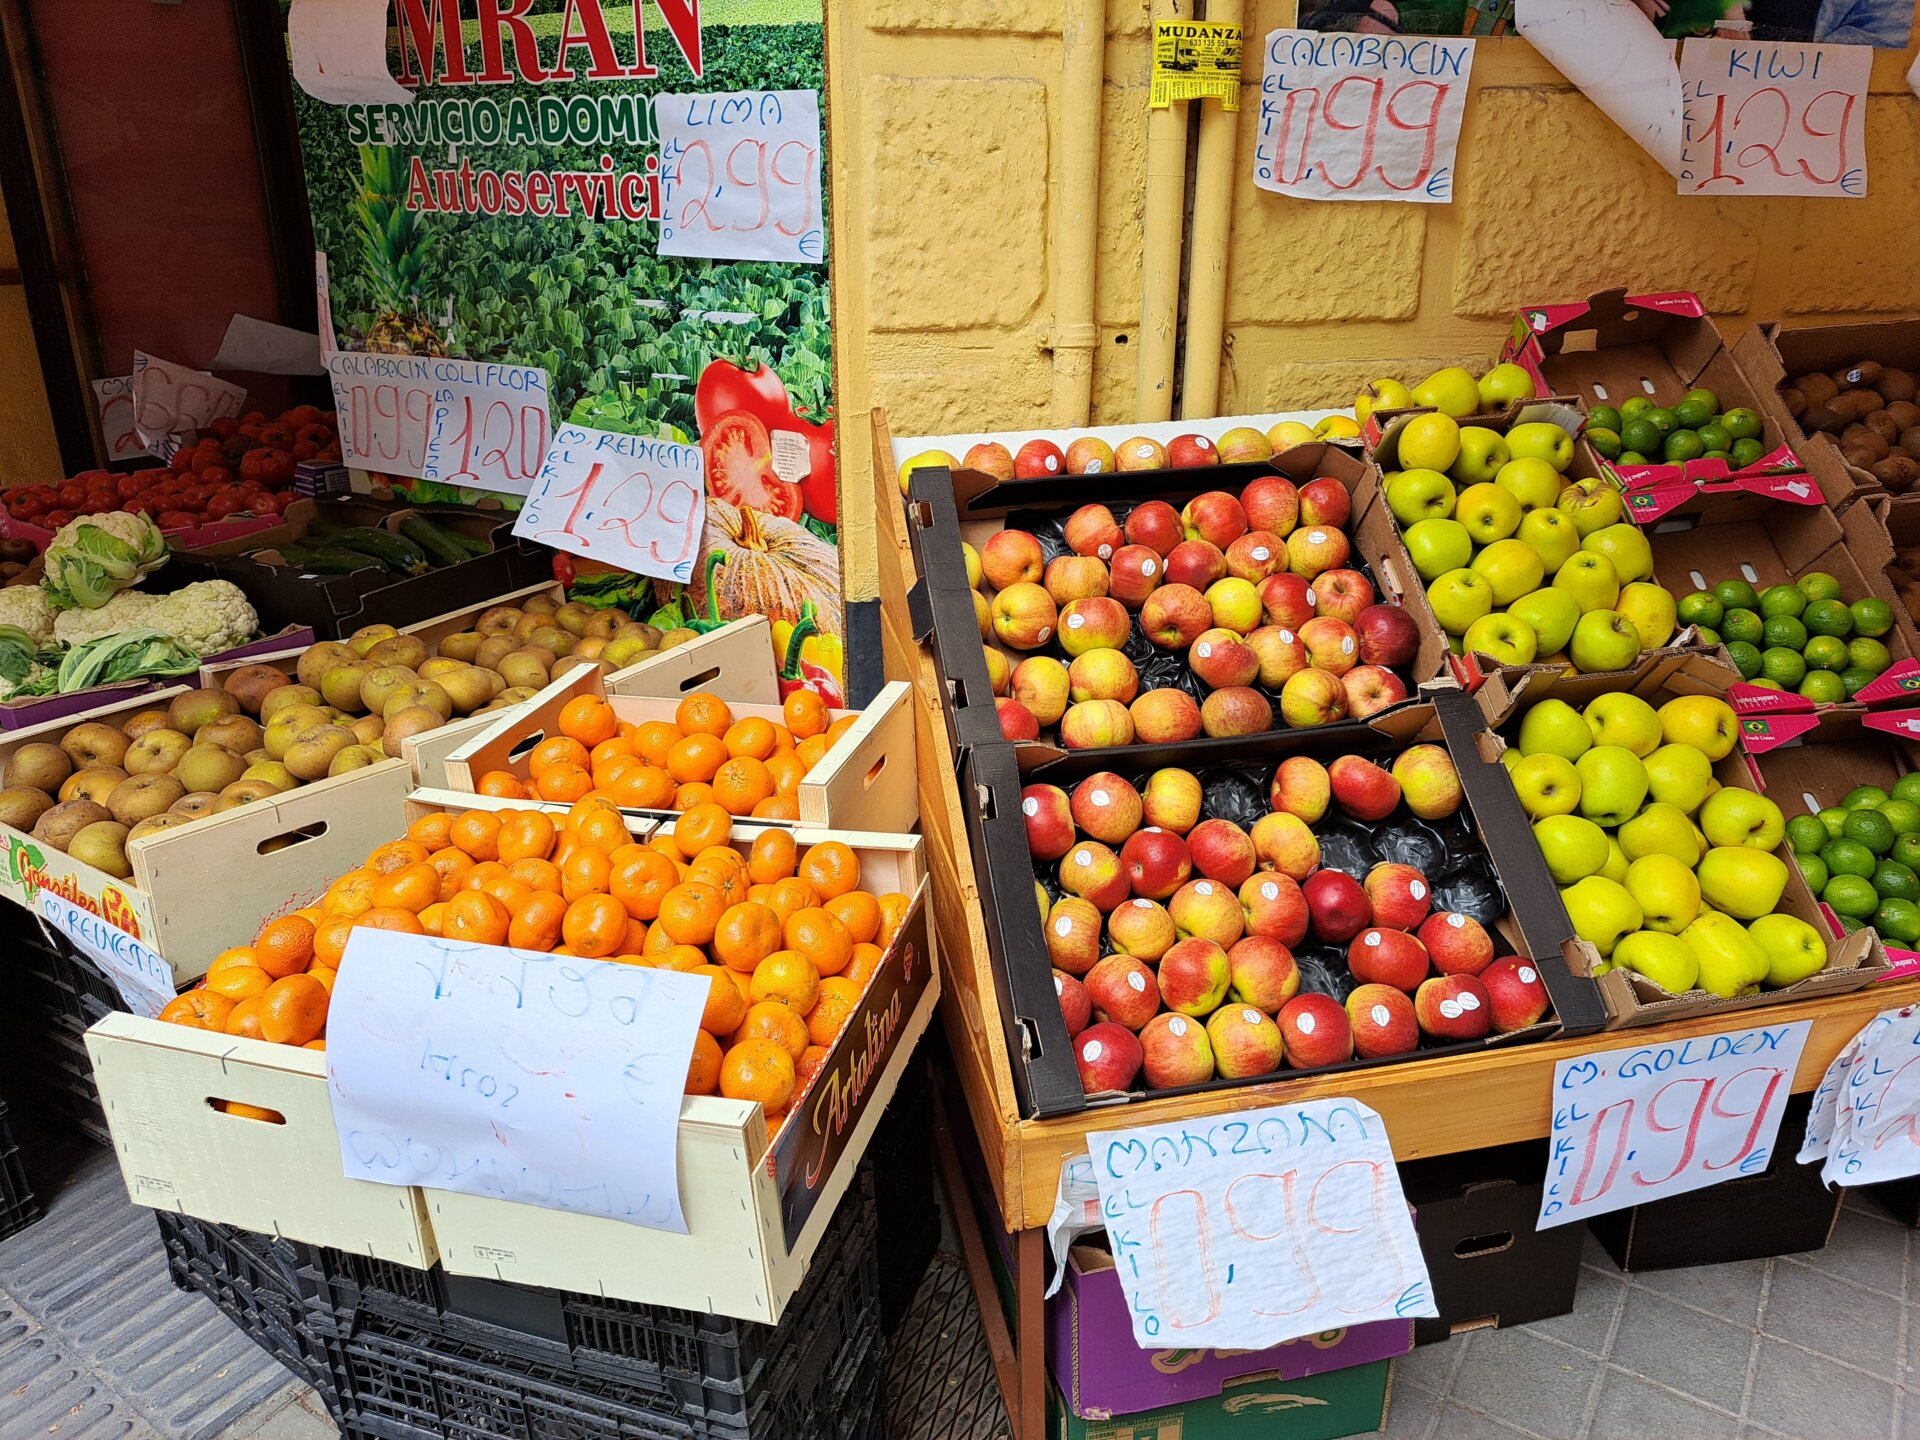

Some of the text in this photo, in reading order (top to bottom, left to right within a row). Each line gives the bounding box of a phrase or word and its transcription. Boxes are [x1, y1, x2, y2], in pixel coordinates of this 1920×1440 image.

[1271, 35, 1468, 77] CALABACIN
[1728, 49, 1823, 80] KIWI
[1263, 74, 1293, 94] EL
[348, 102, 500, 145] SERVICIO
[507, 101, 535, 144] A
[687, 93, 783, 128] LIMA
[663, 136, 686, 160] EL
[1426, 167, 1449, 197] €
[1841, 168, 1863, 195] €
[799, 229, 822, 259] €
[330, 356, 429, 380] CALABACIN
[434, 363, 546, 393] COLIFLOR
[435, 389, 455, 403] LA
[548, 451, 575, 464] EL
[673, 561, 692, 580] €
[67, 910, 166, 985] REINETA
[1618, 1027, 1790, 1080] GOLDEN
[1553, 1102, 1589, 1131] EL
[1739, 1148, 1767, 1173] €
[1104, 1190, 1148, 1219] EL
[1394, 1281, 1435, 1317] €
